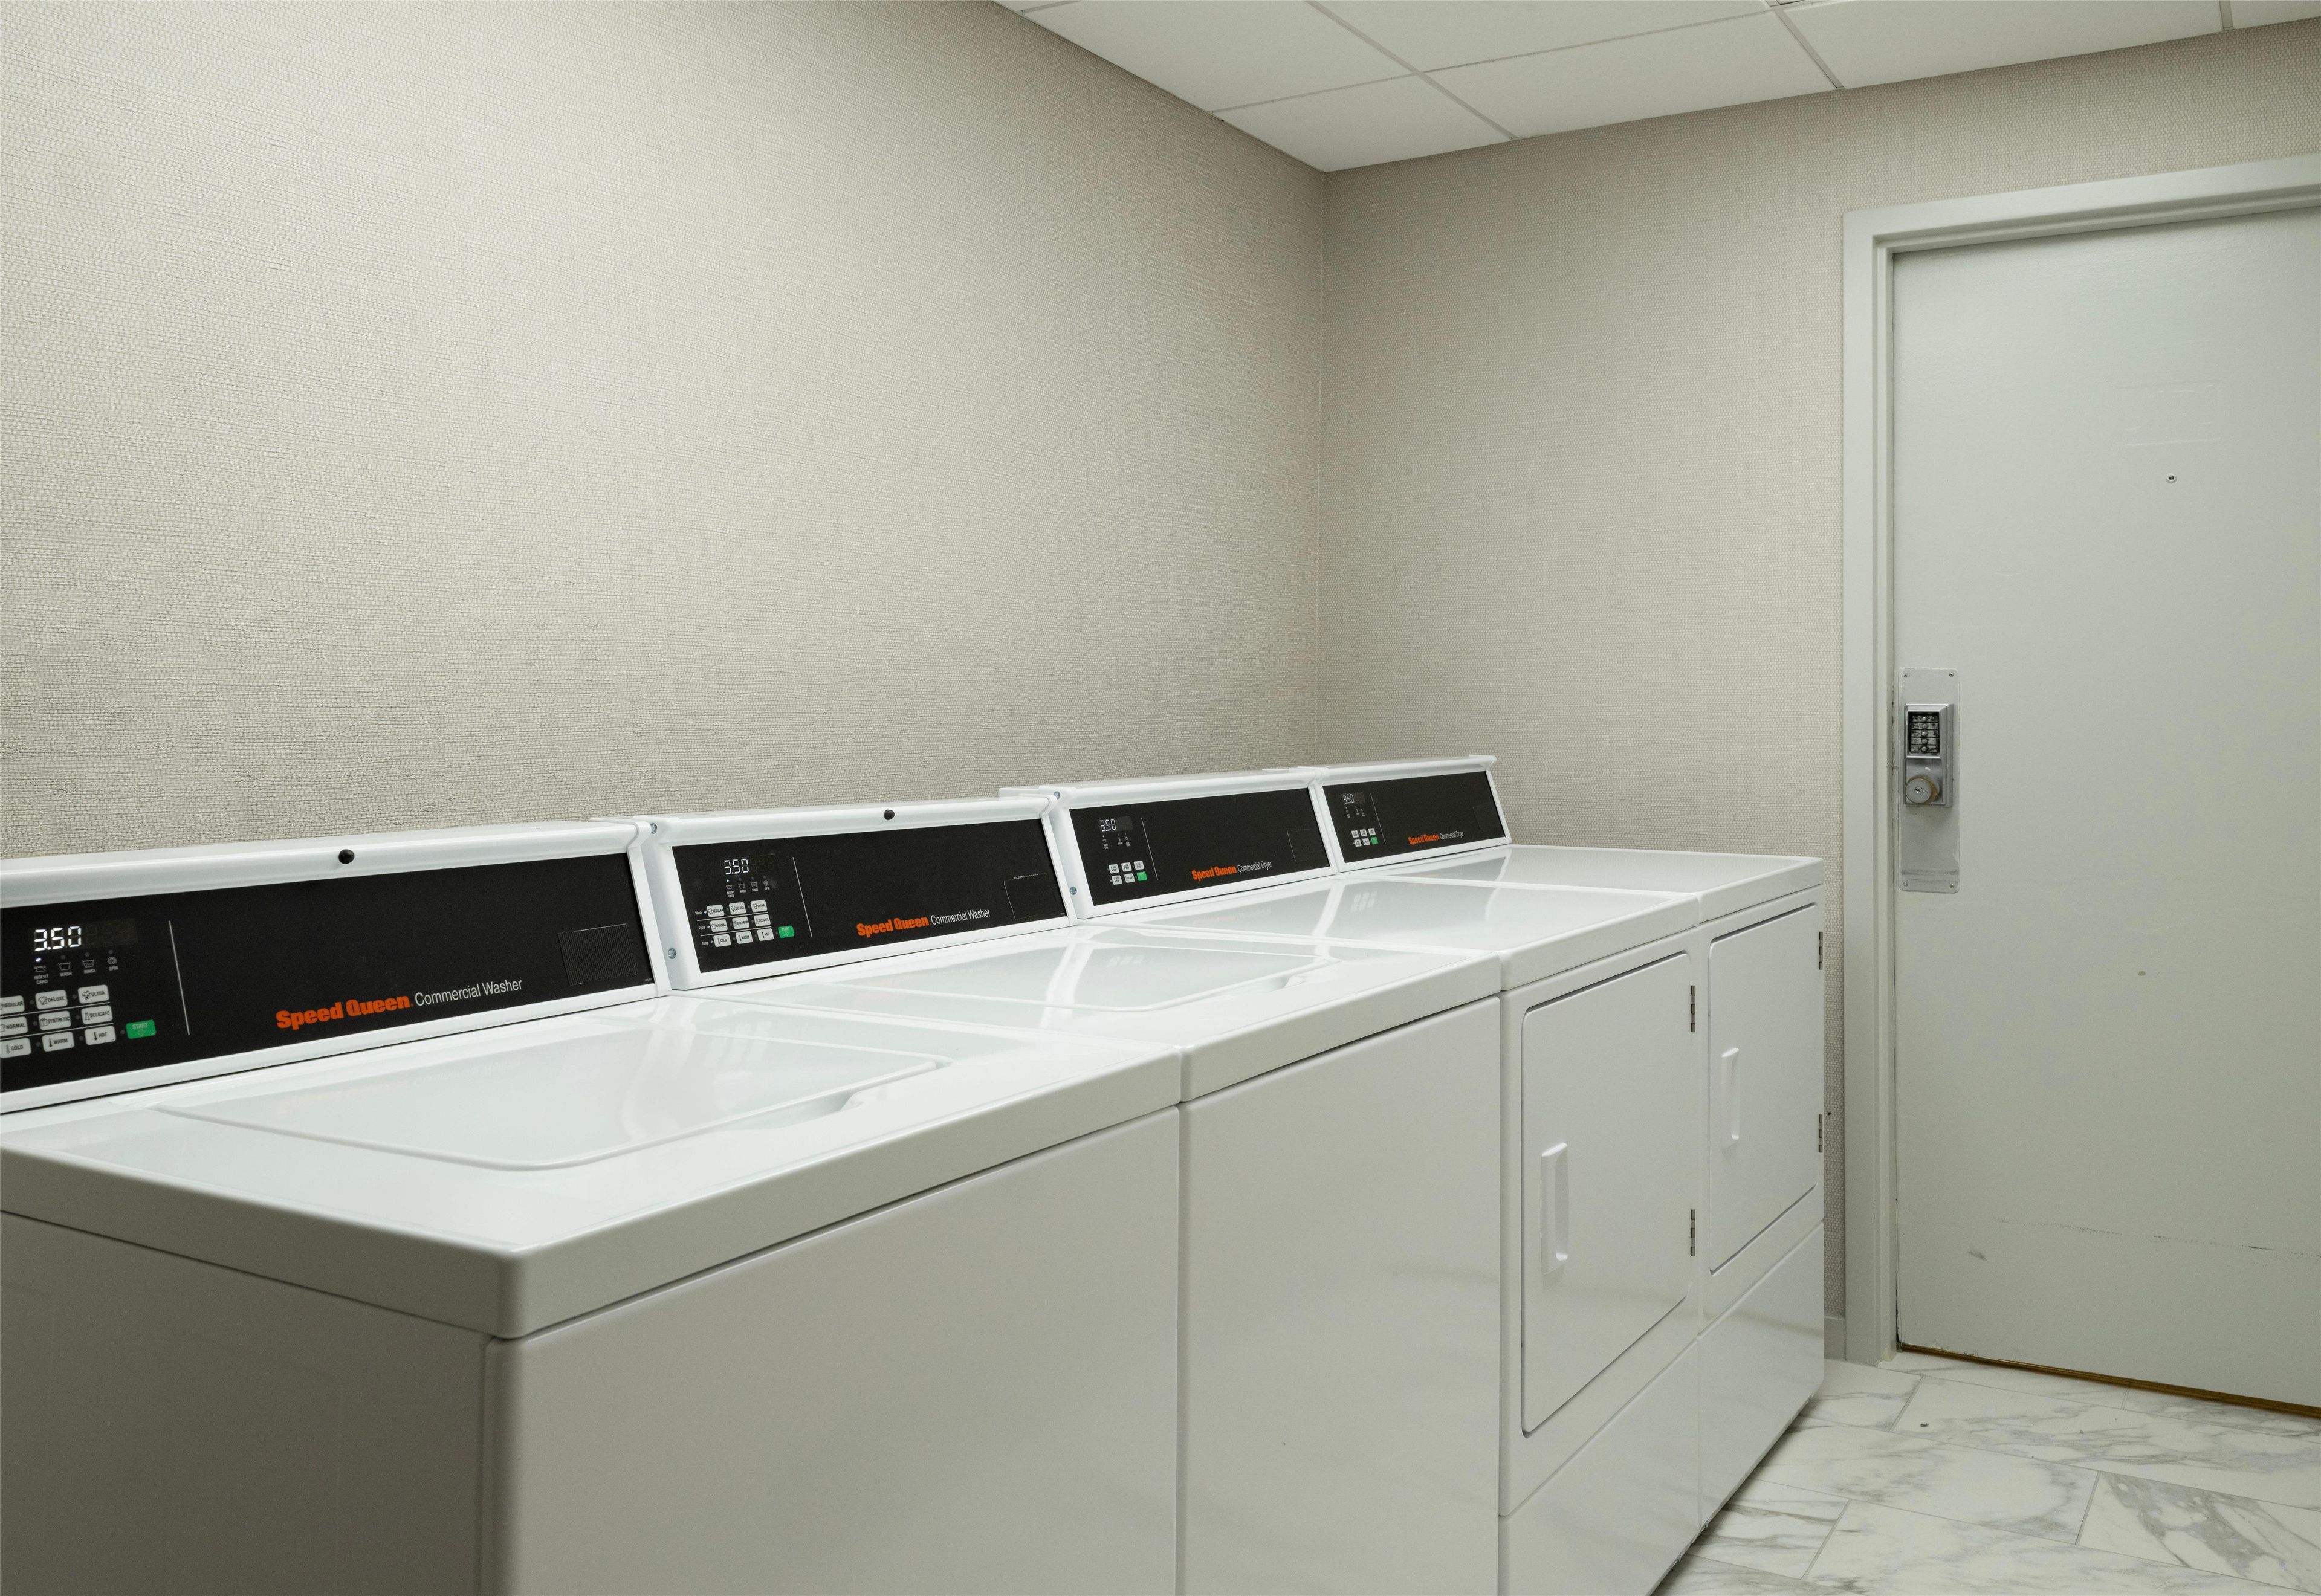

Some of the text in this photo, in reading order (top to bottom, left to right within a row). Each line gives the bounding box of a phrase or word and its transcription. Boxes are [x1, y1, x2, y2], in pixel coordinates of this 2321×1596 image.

[1100, 819, 1116, 832] 3.50
[1408, 835, 1424, 846] Speed
[1424, 833, 1440, 842] Queen
[1439, 832, 1455, 840] Commercial
[724, 858, 749, 875] 3.50
[1192, 861, 1272, 881] Speed Queen Commercial Dryer
[856, 908, 991, 937] Speed Queen Commercial Washer
[34, 926, 82, 951] 3.50
[276, 978, 523, 1030] Speed Queen Commercial Washer
